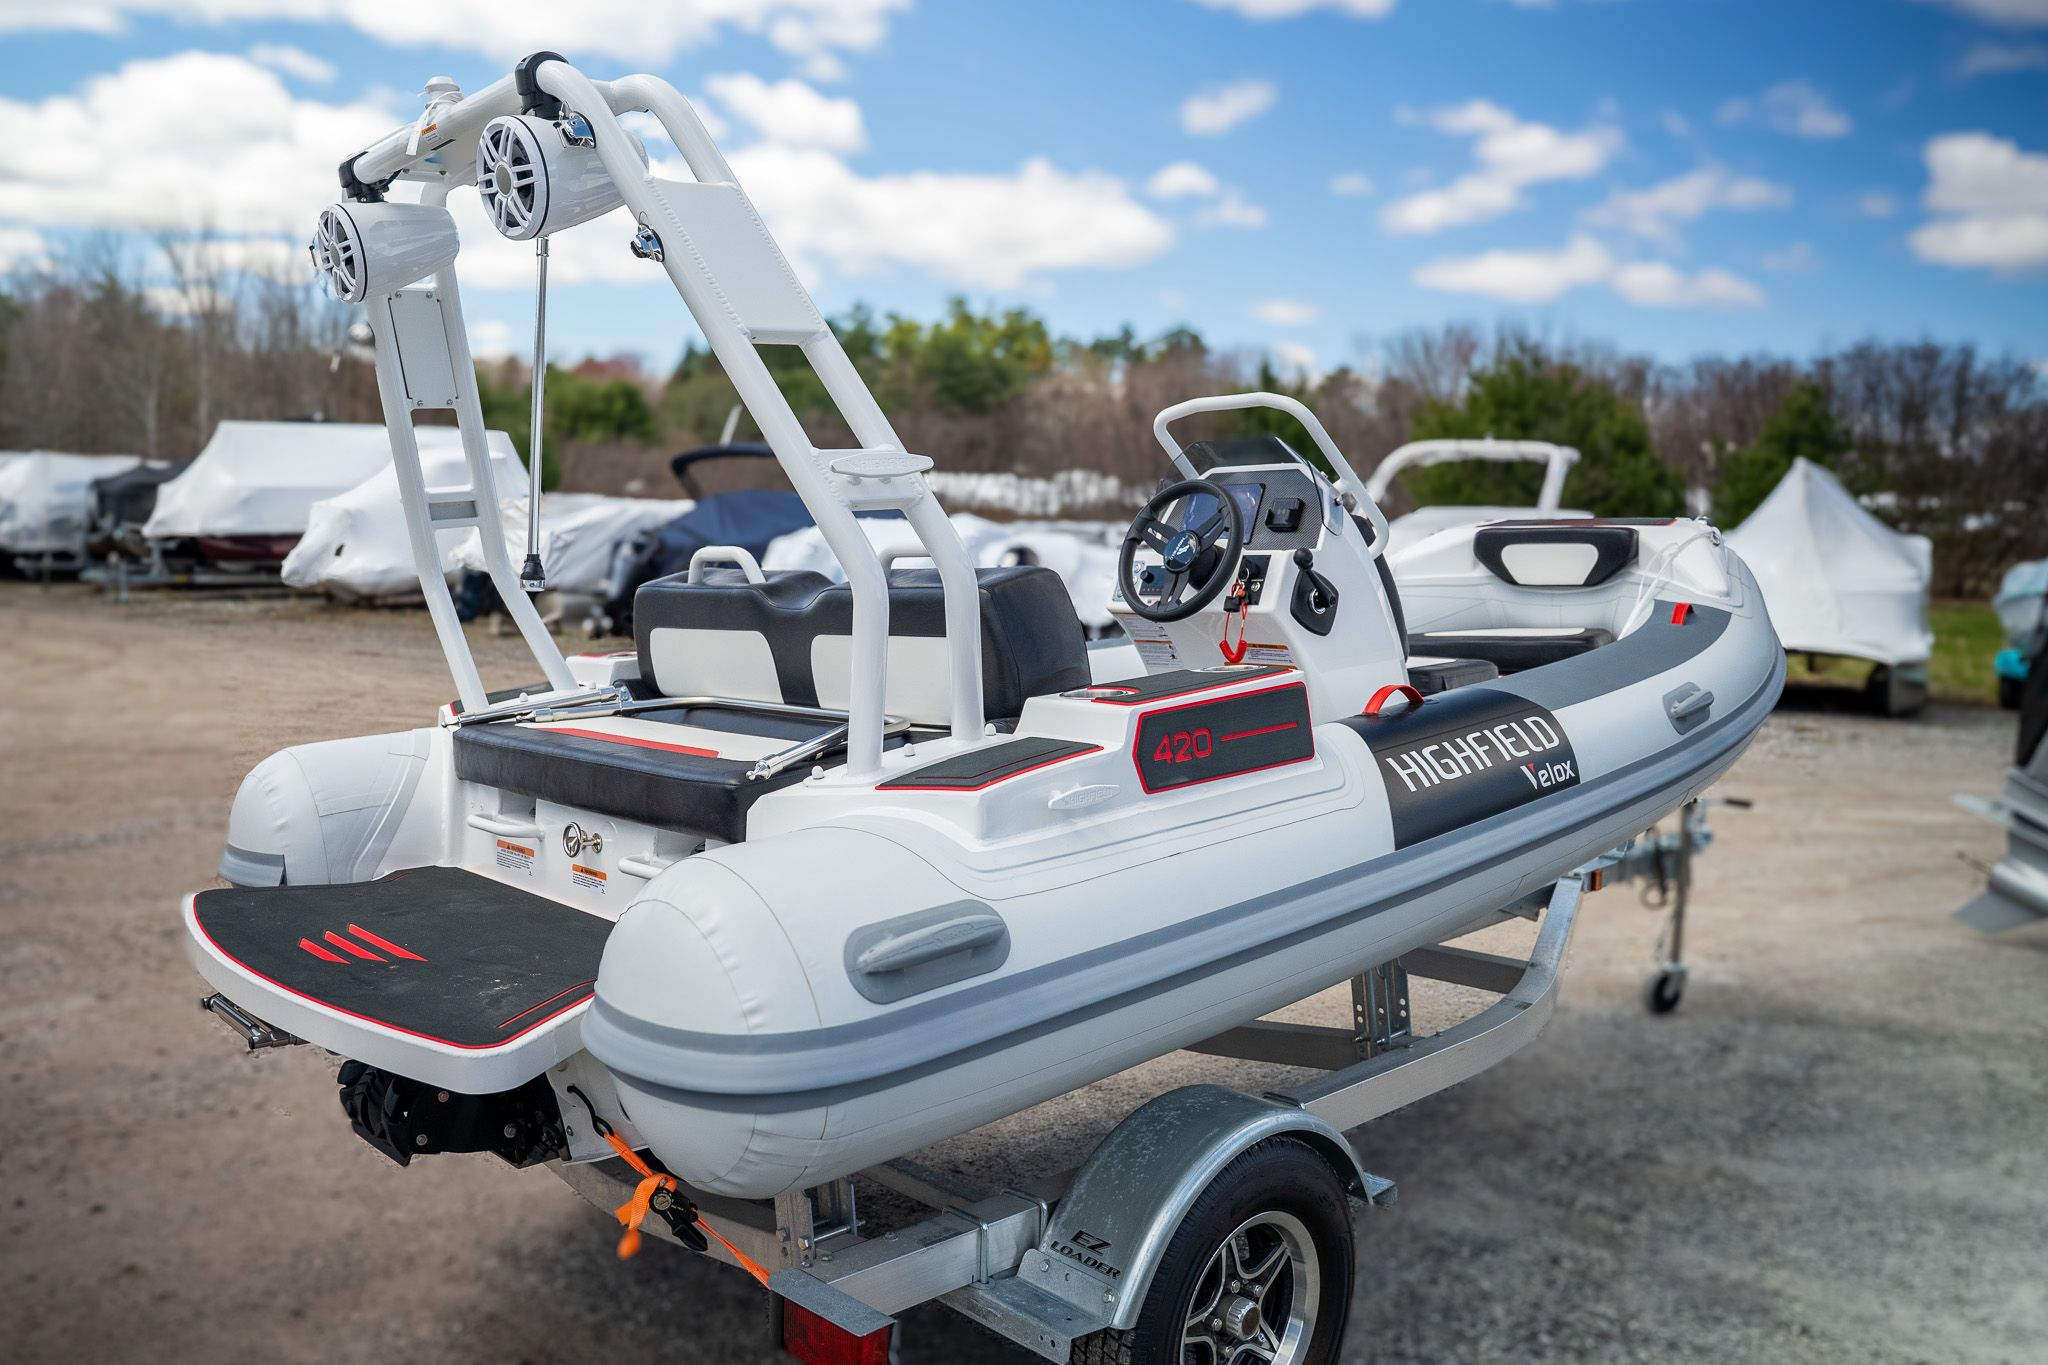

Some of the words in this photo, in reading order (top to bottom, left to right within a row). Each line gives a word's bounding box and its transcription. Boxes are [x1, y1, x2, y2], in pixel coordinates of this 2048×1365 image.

[1153, 728, 1212, 764] 420
[1385, 716, 1560, 792] HIGHFIELD
[1520, 760, 1576, 790] Velox
[1050, 1240, 1121, 1280] LOADER
[1070, 1230, 1112, 1256] EZ
